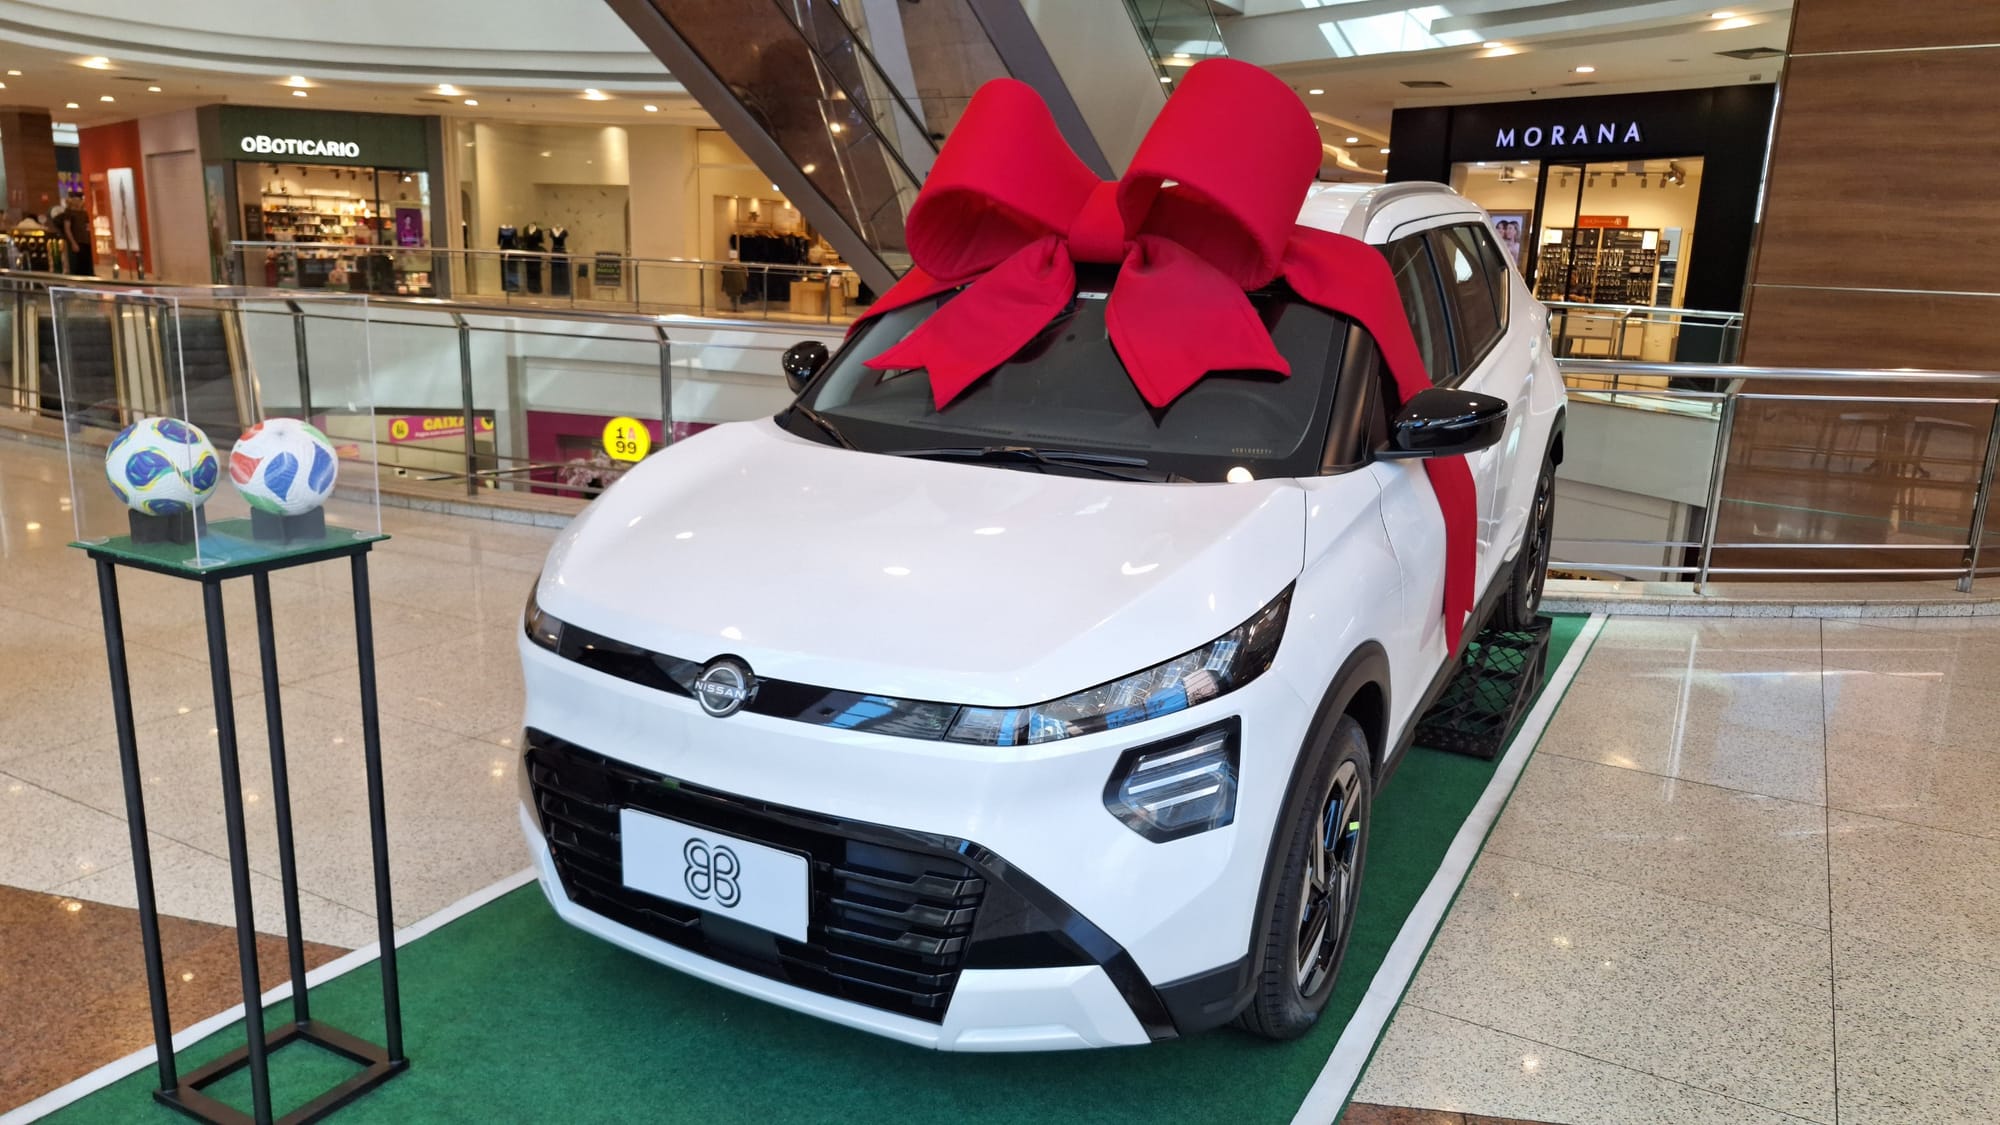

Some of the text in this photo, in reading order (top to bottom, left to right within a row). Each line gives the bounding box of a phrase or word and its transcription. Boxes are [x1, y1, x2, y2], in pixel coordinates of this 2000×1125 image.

[1496, 121, 1641, 148] MORANA
[616, 441, 637, 454] 99
[695, 680, 747, 701] NISSAN
